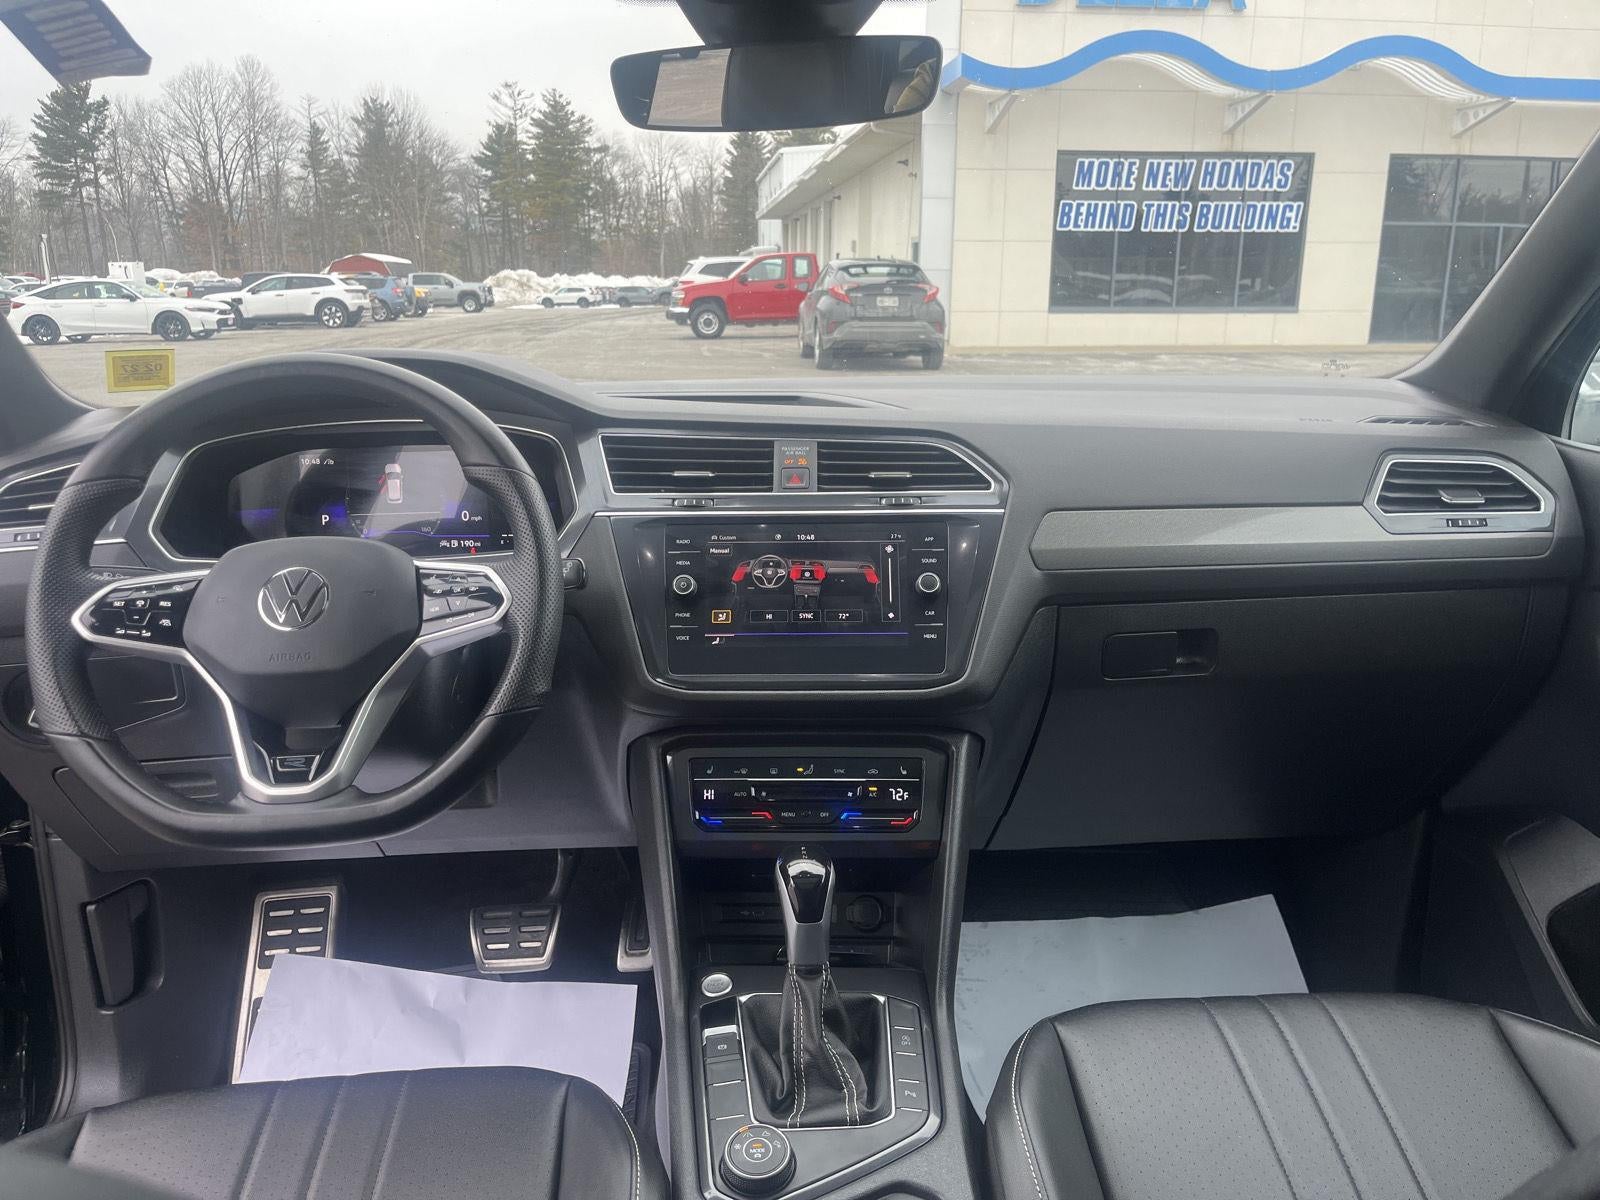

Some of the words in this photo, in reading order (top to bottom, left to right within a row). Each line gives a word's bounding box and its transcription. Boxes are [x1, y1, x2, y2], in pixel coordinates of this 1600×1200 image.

[1073, 158, 1139, 191] MORE
[1142, 158, 1196, 191] NEW
[1198, 159, 1294, 191] HONDAS
[1056, 200, 1137, 232] BEHIND
[1141, 200, 1192, 232] THIS
[1193, 200, 1303, 232] BUILDING!
[321, 515, 330, 525] P
[461, 510, 469, 521] 0
[269, 652, 311, 662] AIRBAG
[703, 789, 715, 800] HI
